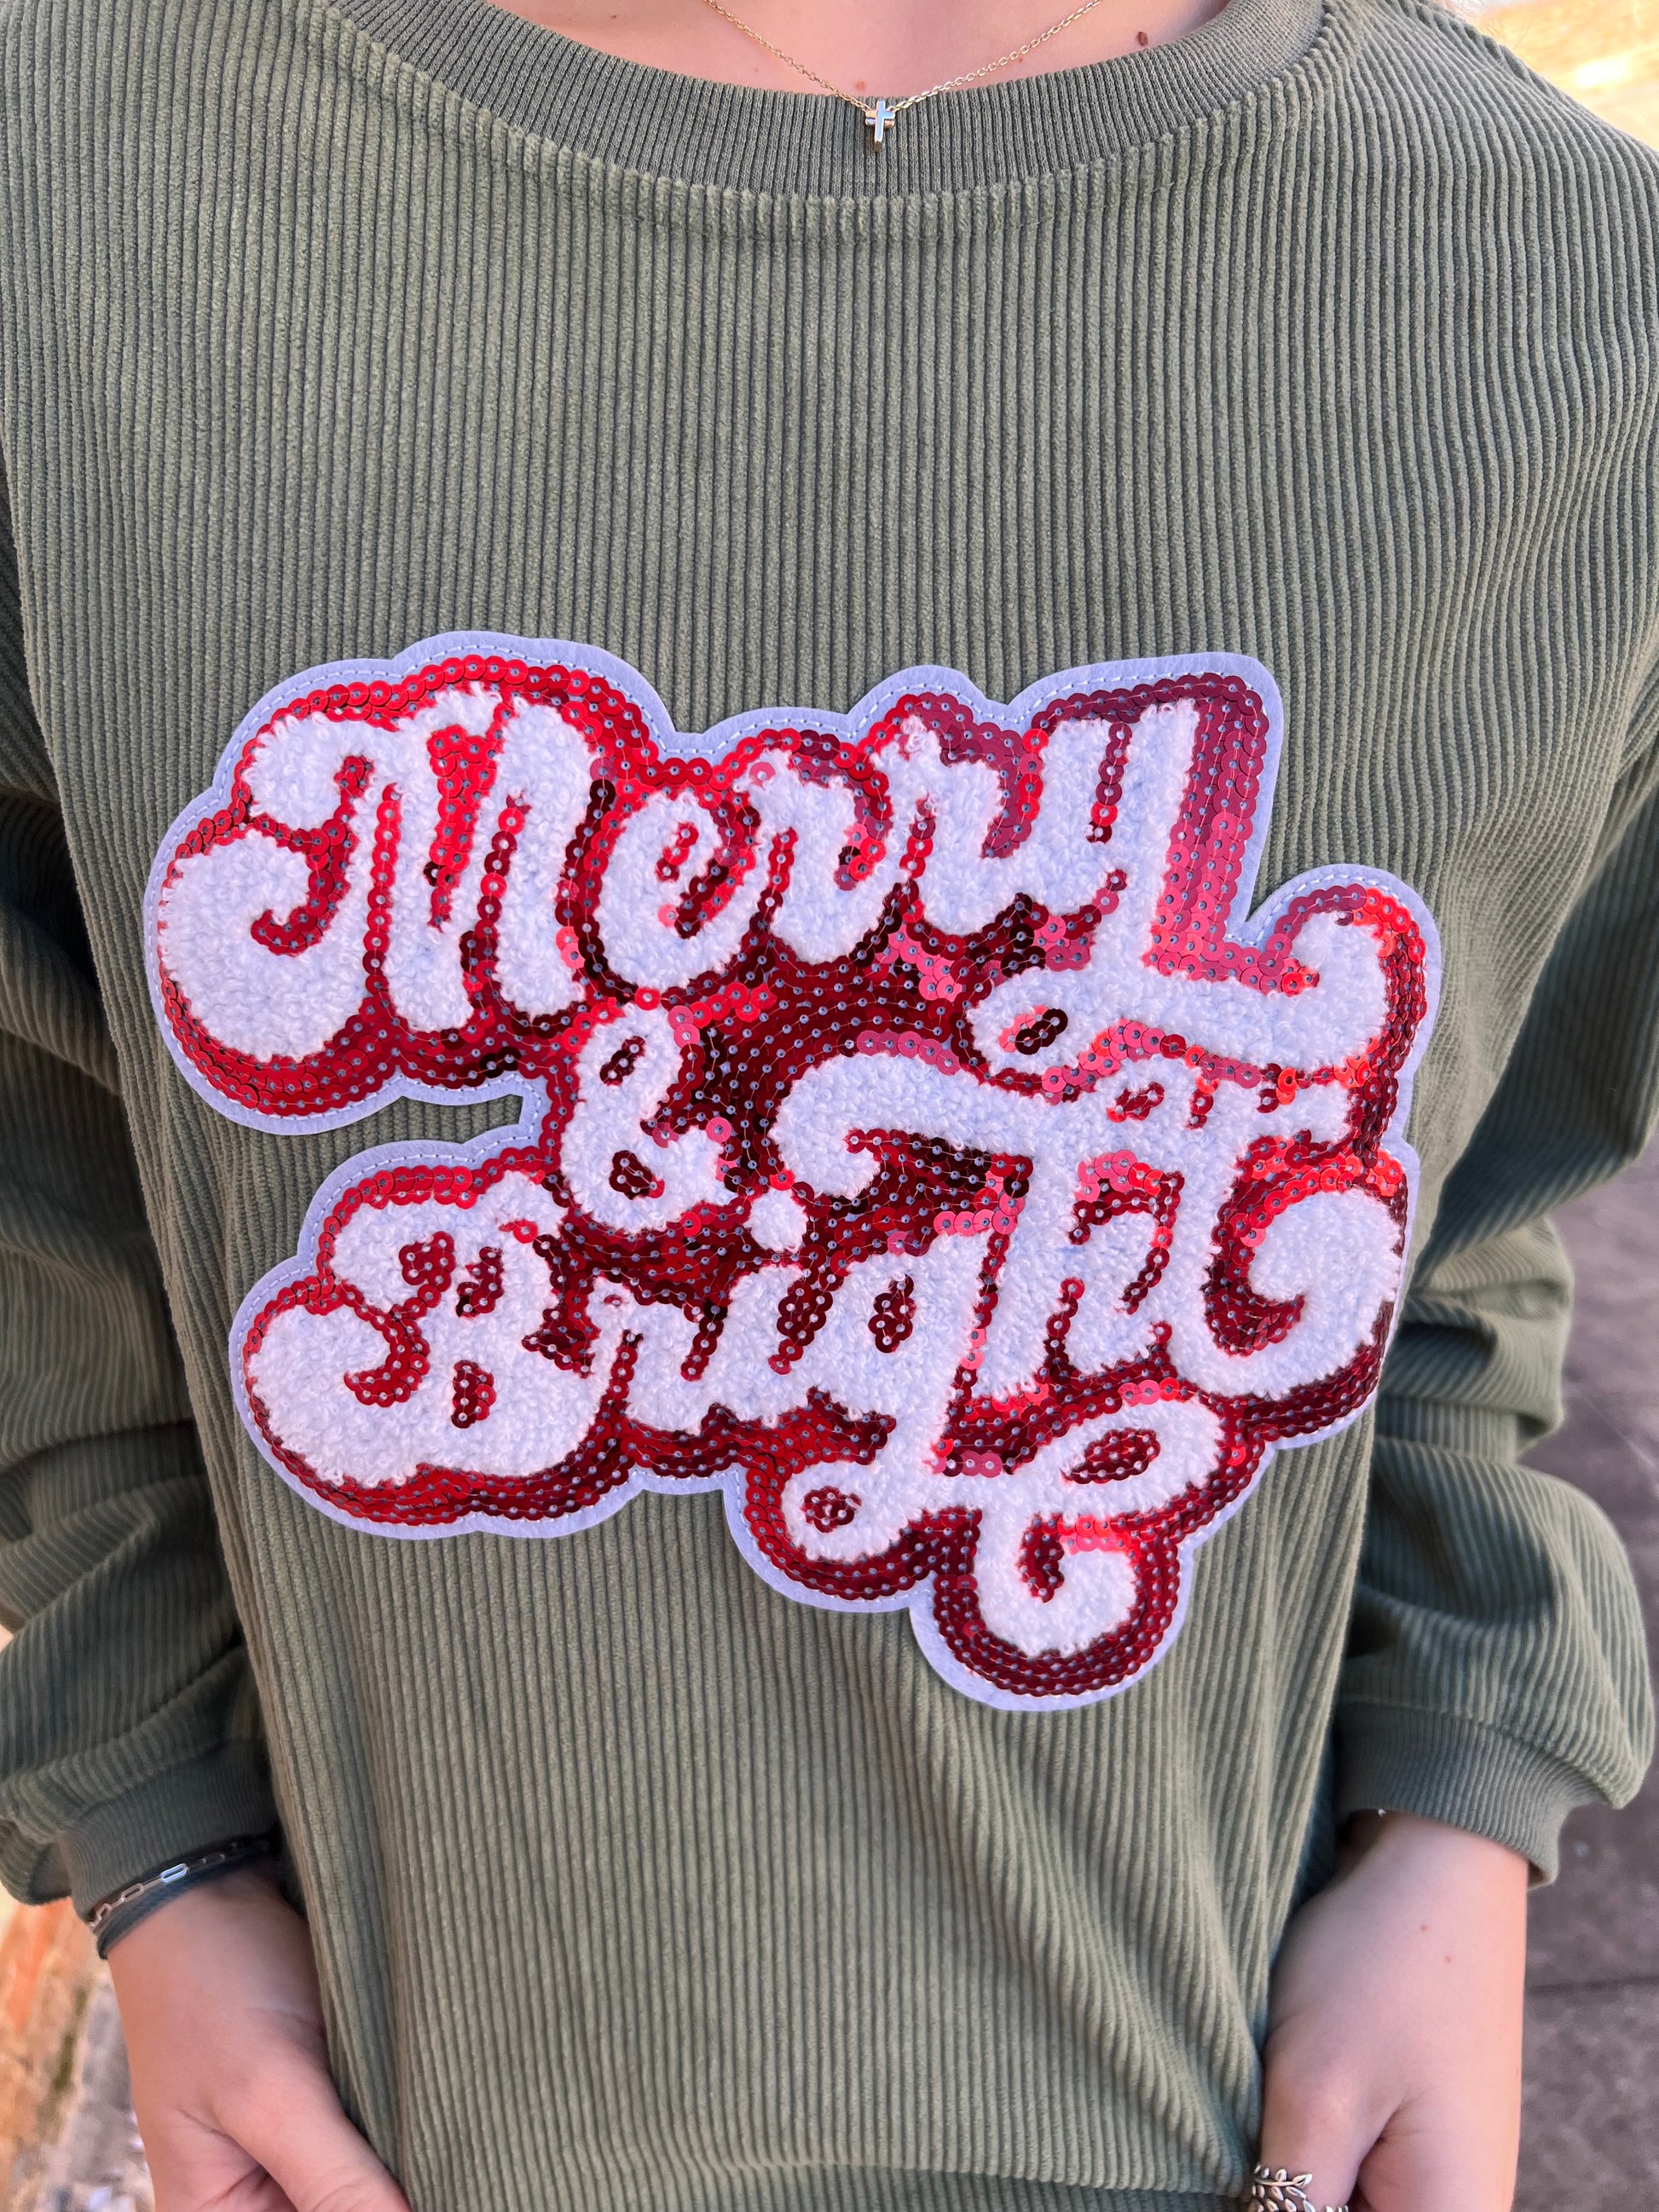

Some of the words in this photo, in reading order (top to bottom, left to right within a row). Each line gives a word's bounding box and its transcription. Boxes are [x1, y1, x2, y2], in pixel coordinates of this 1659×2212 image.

[159, 684, 1391, 1073] Merry
[561, 1002, 737, 1234] &
[242, 1050, 1403, 1655] Bright
